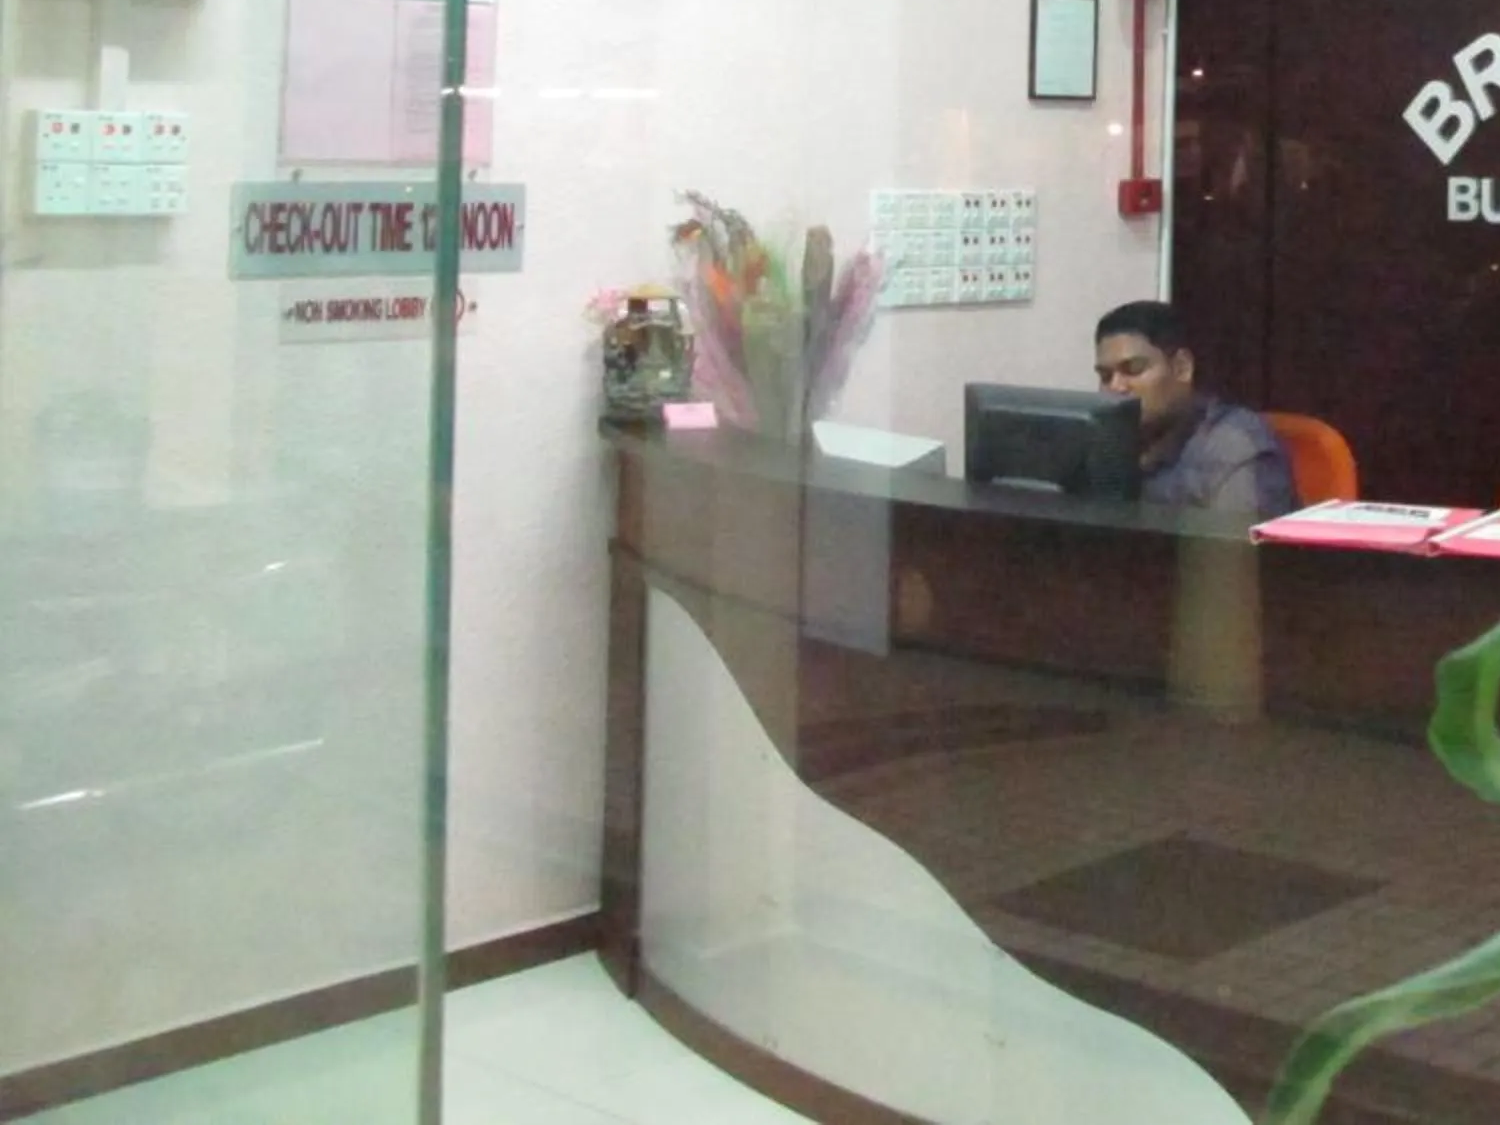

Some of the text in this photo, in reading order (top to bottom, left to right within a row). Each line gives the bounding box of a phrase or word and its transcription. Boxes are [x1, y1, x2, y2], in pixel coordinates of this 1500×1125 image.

[244, 202, 363, 255] CHECK-OUT
[368, 202, 414, 252] TIME
[461, 202, 515, 251] NOON
[326, 297, 383, 323] SMOKING
